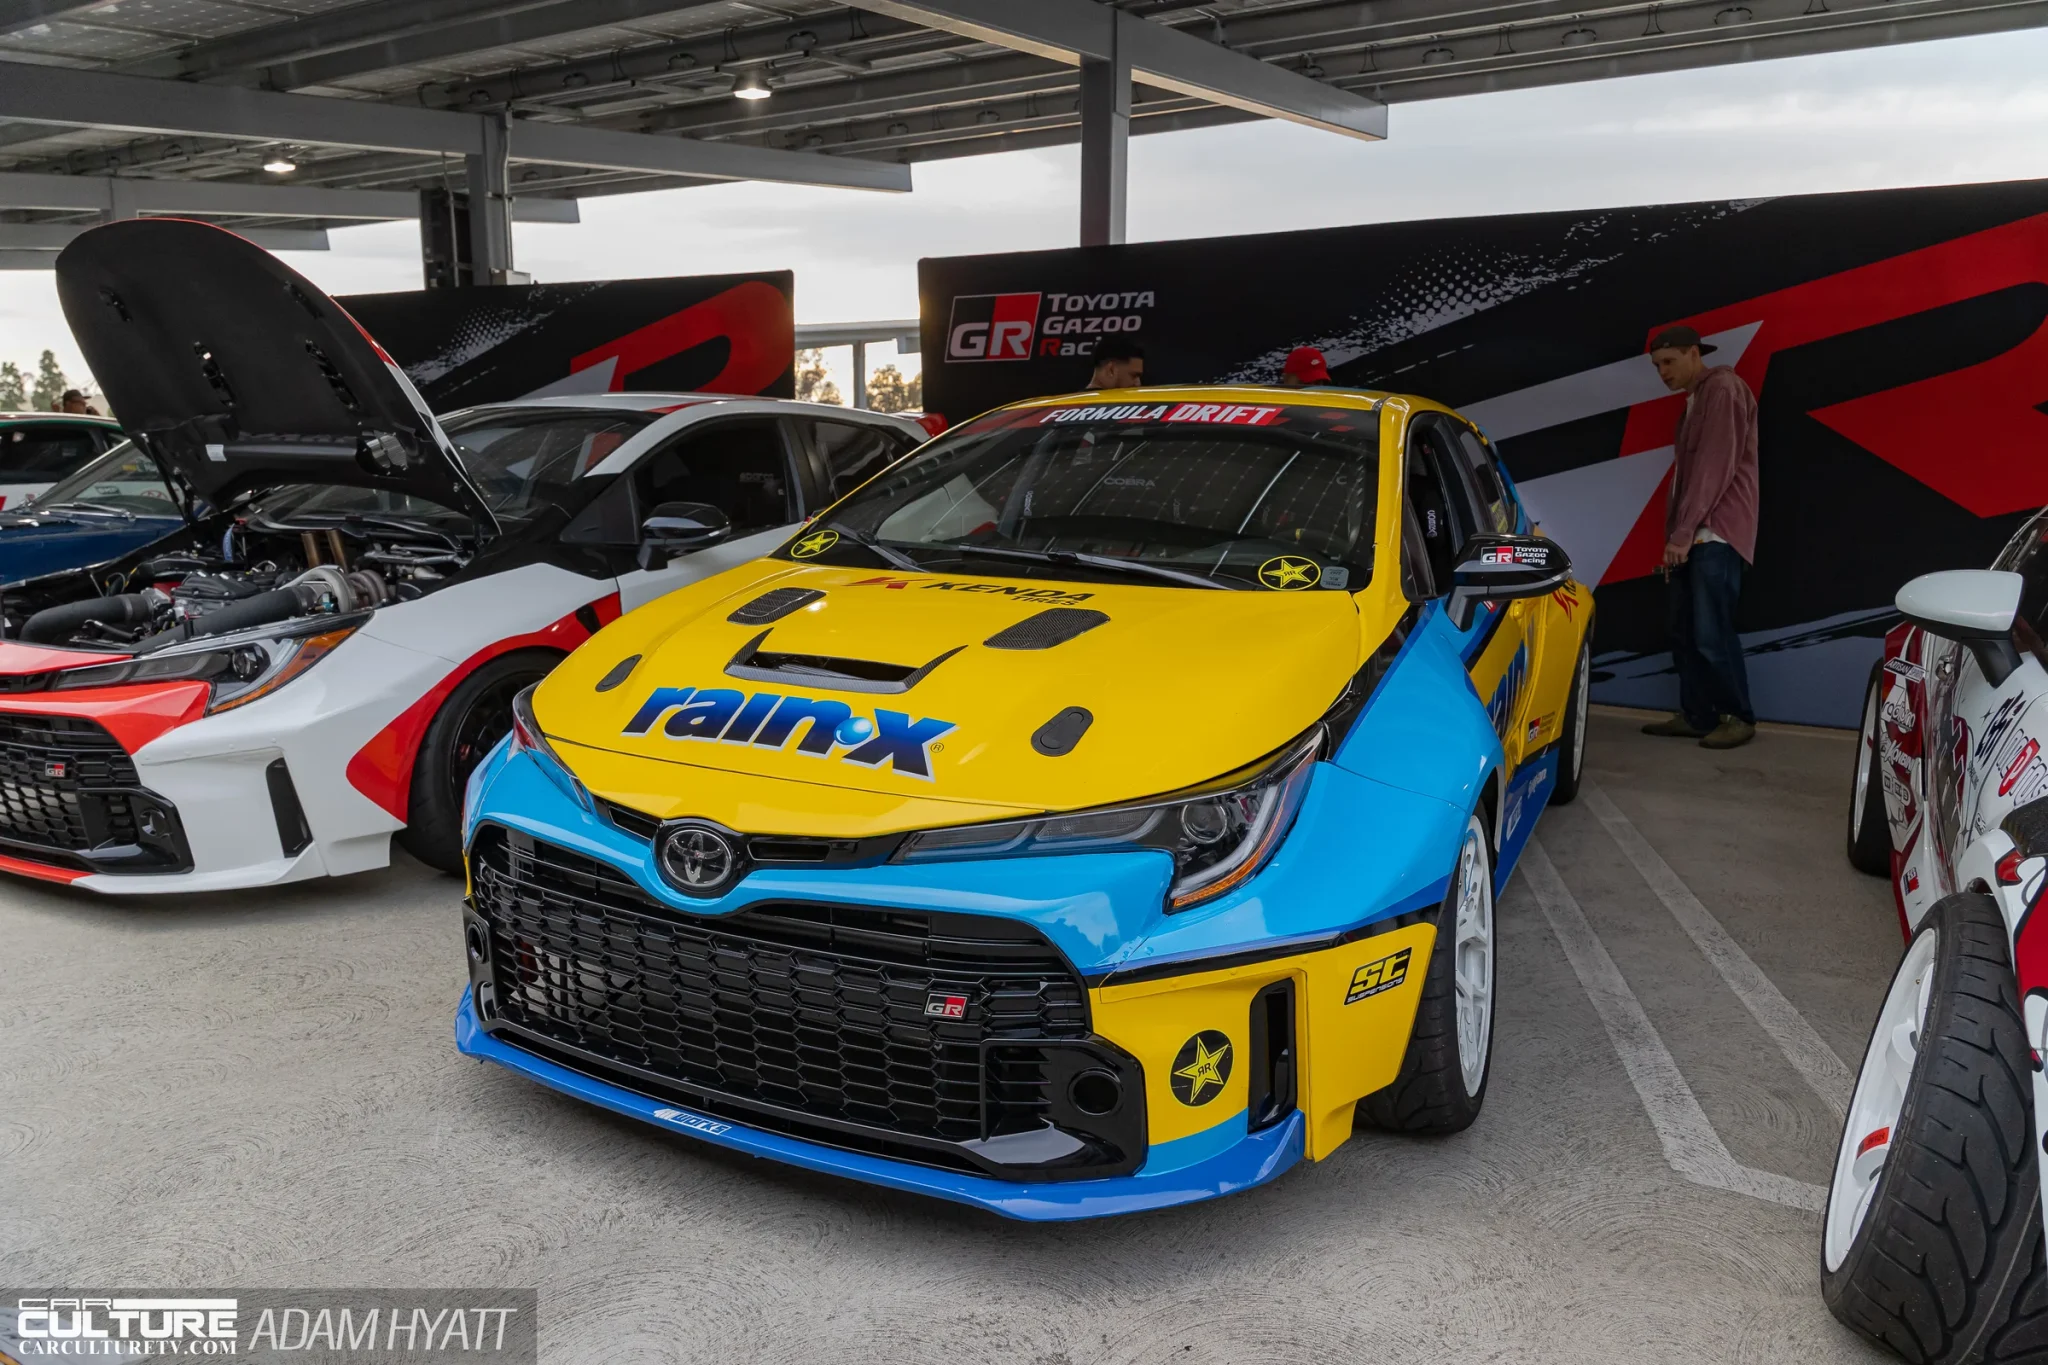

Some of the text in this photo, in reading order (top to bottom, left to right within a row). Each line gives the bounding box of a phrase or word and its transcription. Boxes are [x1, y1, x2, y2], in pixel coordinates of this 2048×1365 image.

[1047, 291, 1155, 312] TOYOTA
[1042, 315, 1142, 335] GAZOO
[949, 320, 1033, 357] GR
[1040, 404, 1276, 424] FORMULA DRIFT
[1103, 477, 1156, 488] COBRA
[1482, 552, 1512, 563] GR
[1514, 546, 1549, 554] TOYOTA
[922, 582, 1095, 601] KENDA
[1011, 595, 1079, 606] TIRES
[927, 1002, 963, 1016] GR
